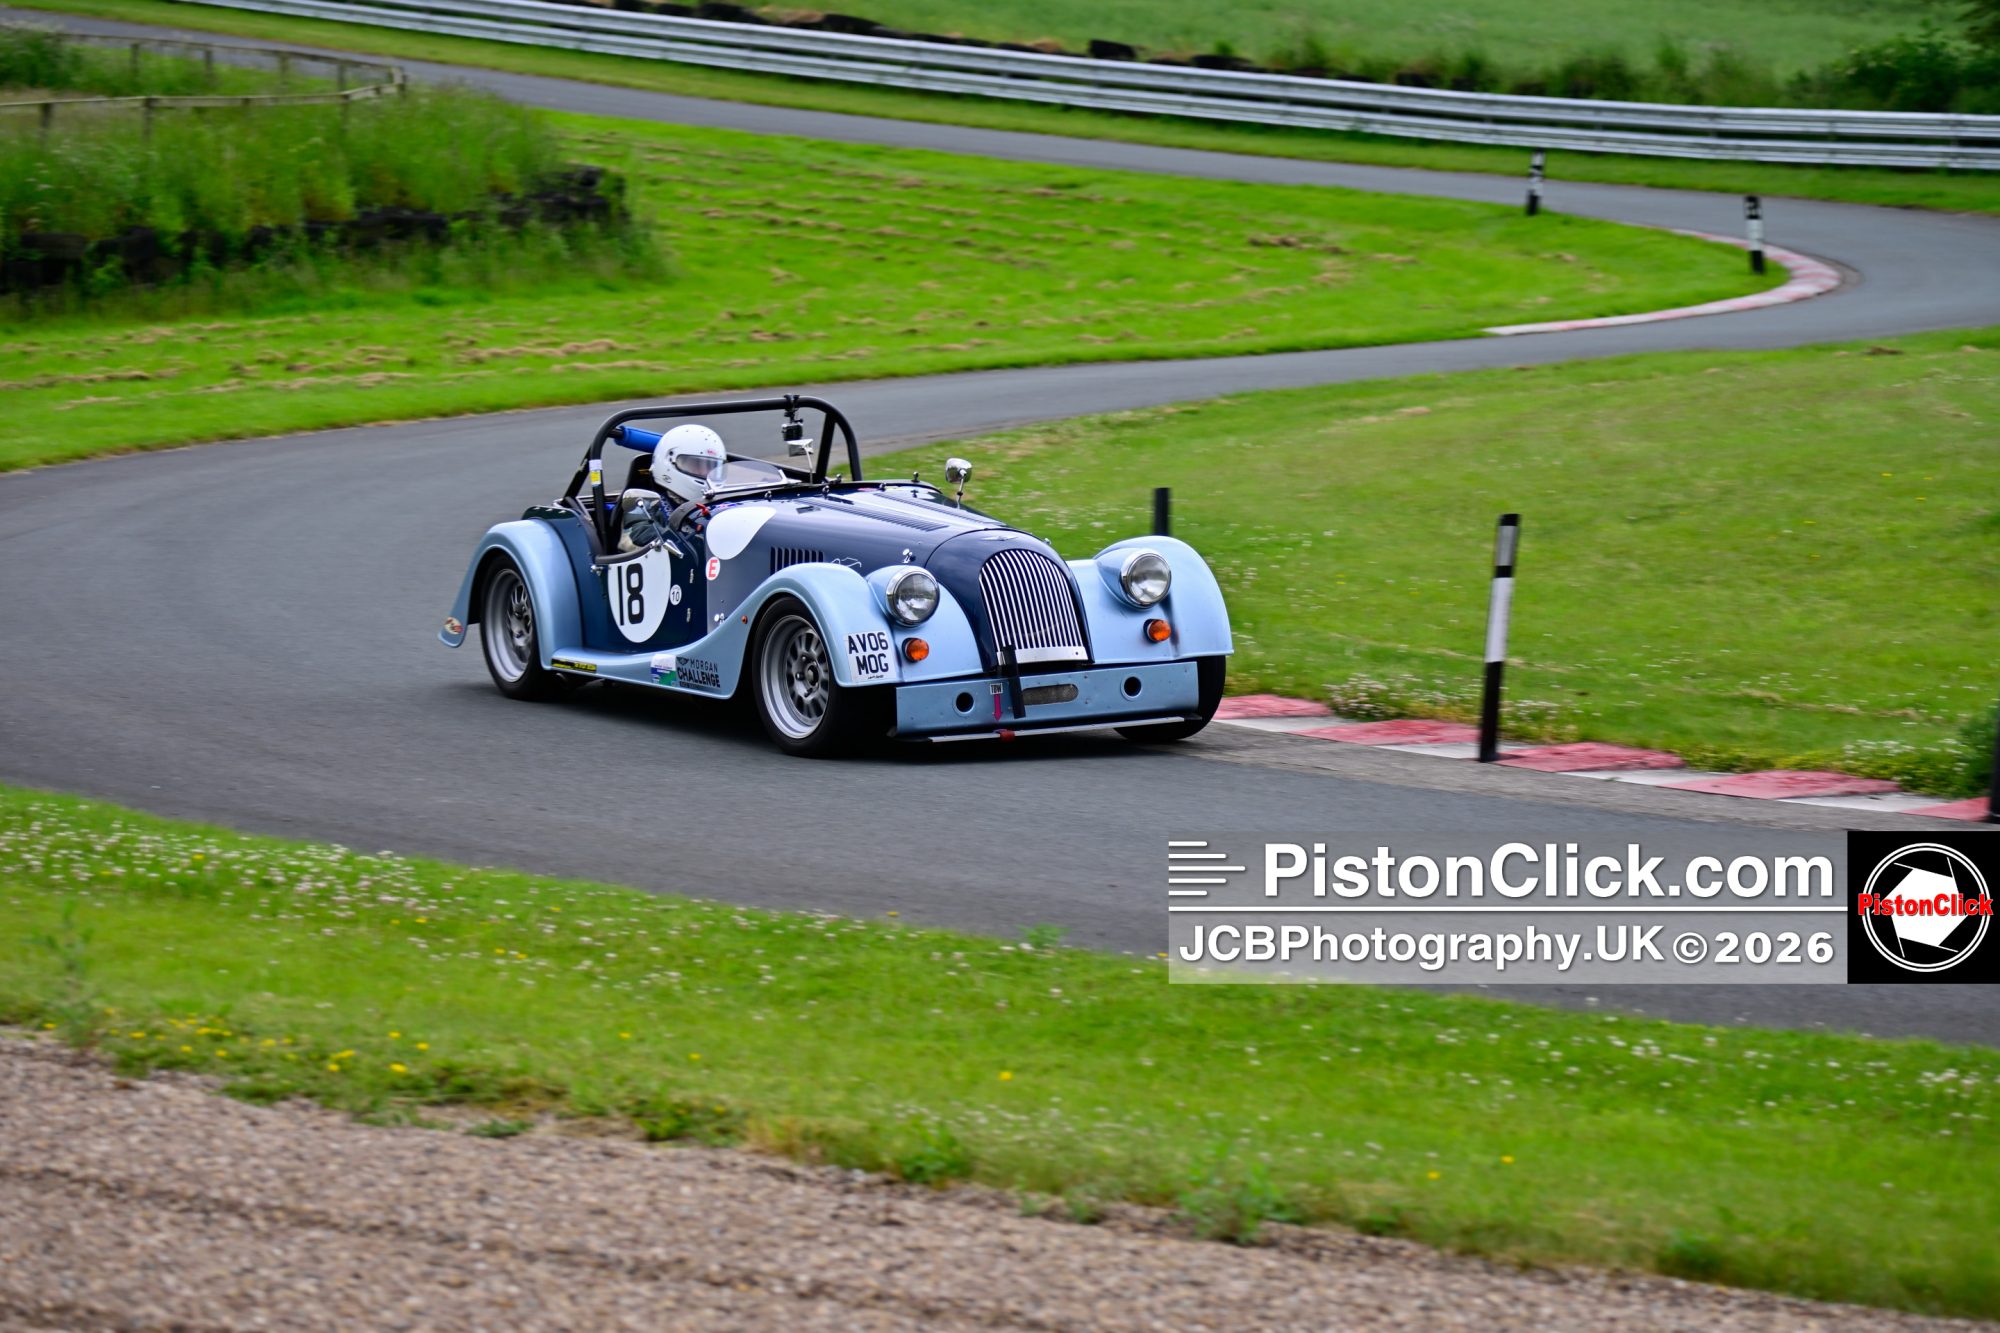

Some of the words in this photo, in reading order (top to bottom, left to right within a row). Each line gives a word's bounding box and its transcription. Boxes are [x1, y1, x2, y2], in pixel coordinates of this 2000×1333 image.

[708, 559, 718, 578] E
[617, 563, 645, 626] 18
[690, 658, 718, 673] MORGAN
[855, 653, 889, 676] MOG
[677, 666, 721, 688] CHALLENGE
